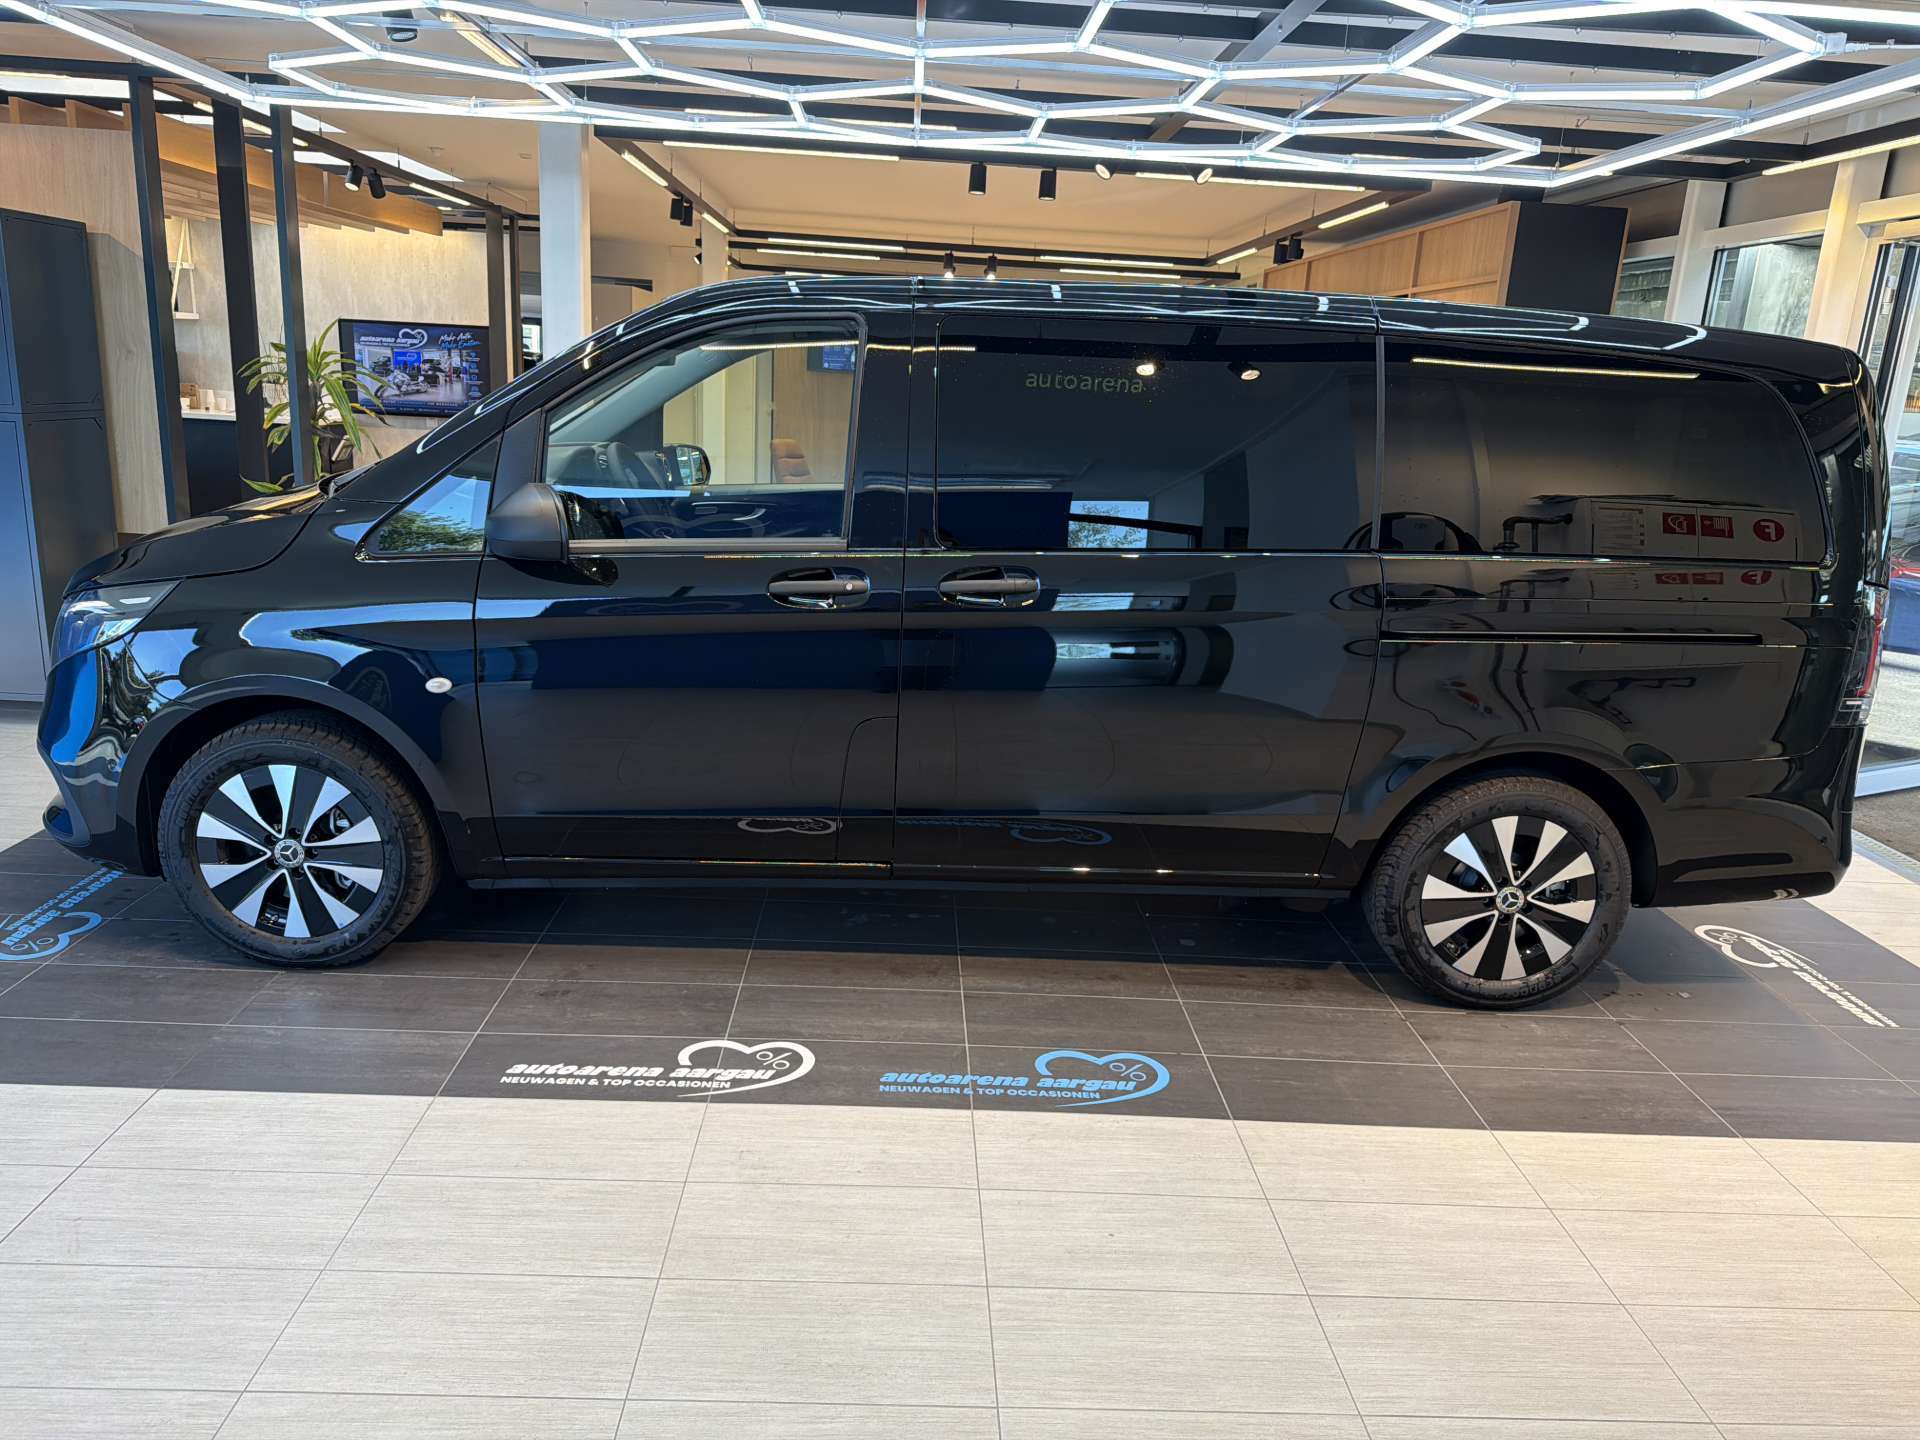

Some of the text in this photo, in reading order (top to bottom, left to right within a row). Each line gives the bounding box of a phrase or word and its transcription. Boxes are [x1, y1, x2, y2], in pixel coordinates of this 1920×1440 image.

[1025, 372, 1144, 393] autoarena
[505, 1063, 776, 1081] autoarena aargau
[500, 1076, 586, 1085] NEUWAGEN
[603, 1078, 632, 1087] TOP
[633, 1079, 731, 1089] OCCASIONEN
[880, 1072, 1136, 1091] autoarena aargau
[880, 1085, 1101, 1099] NEUWAGEN & TOP OCCASIONEN
